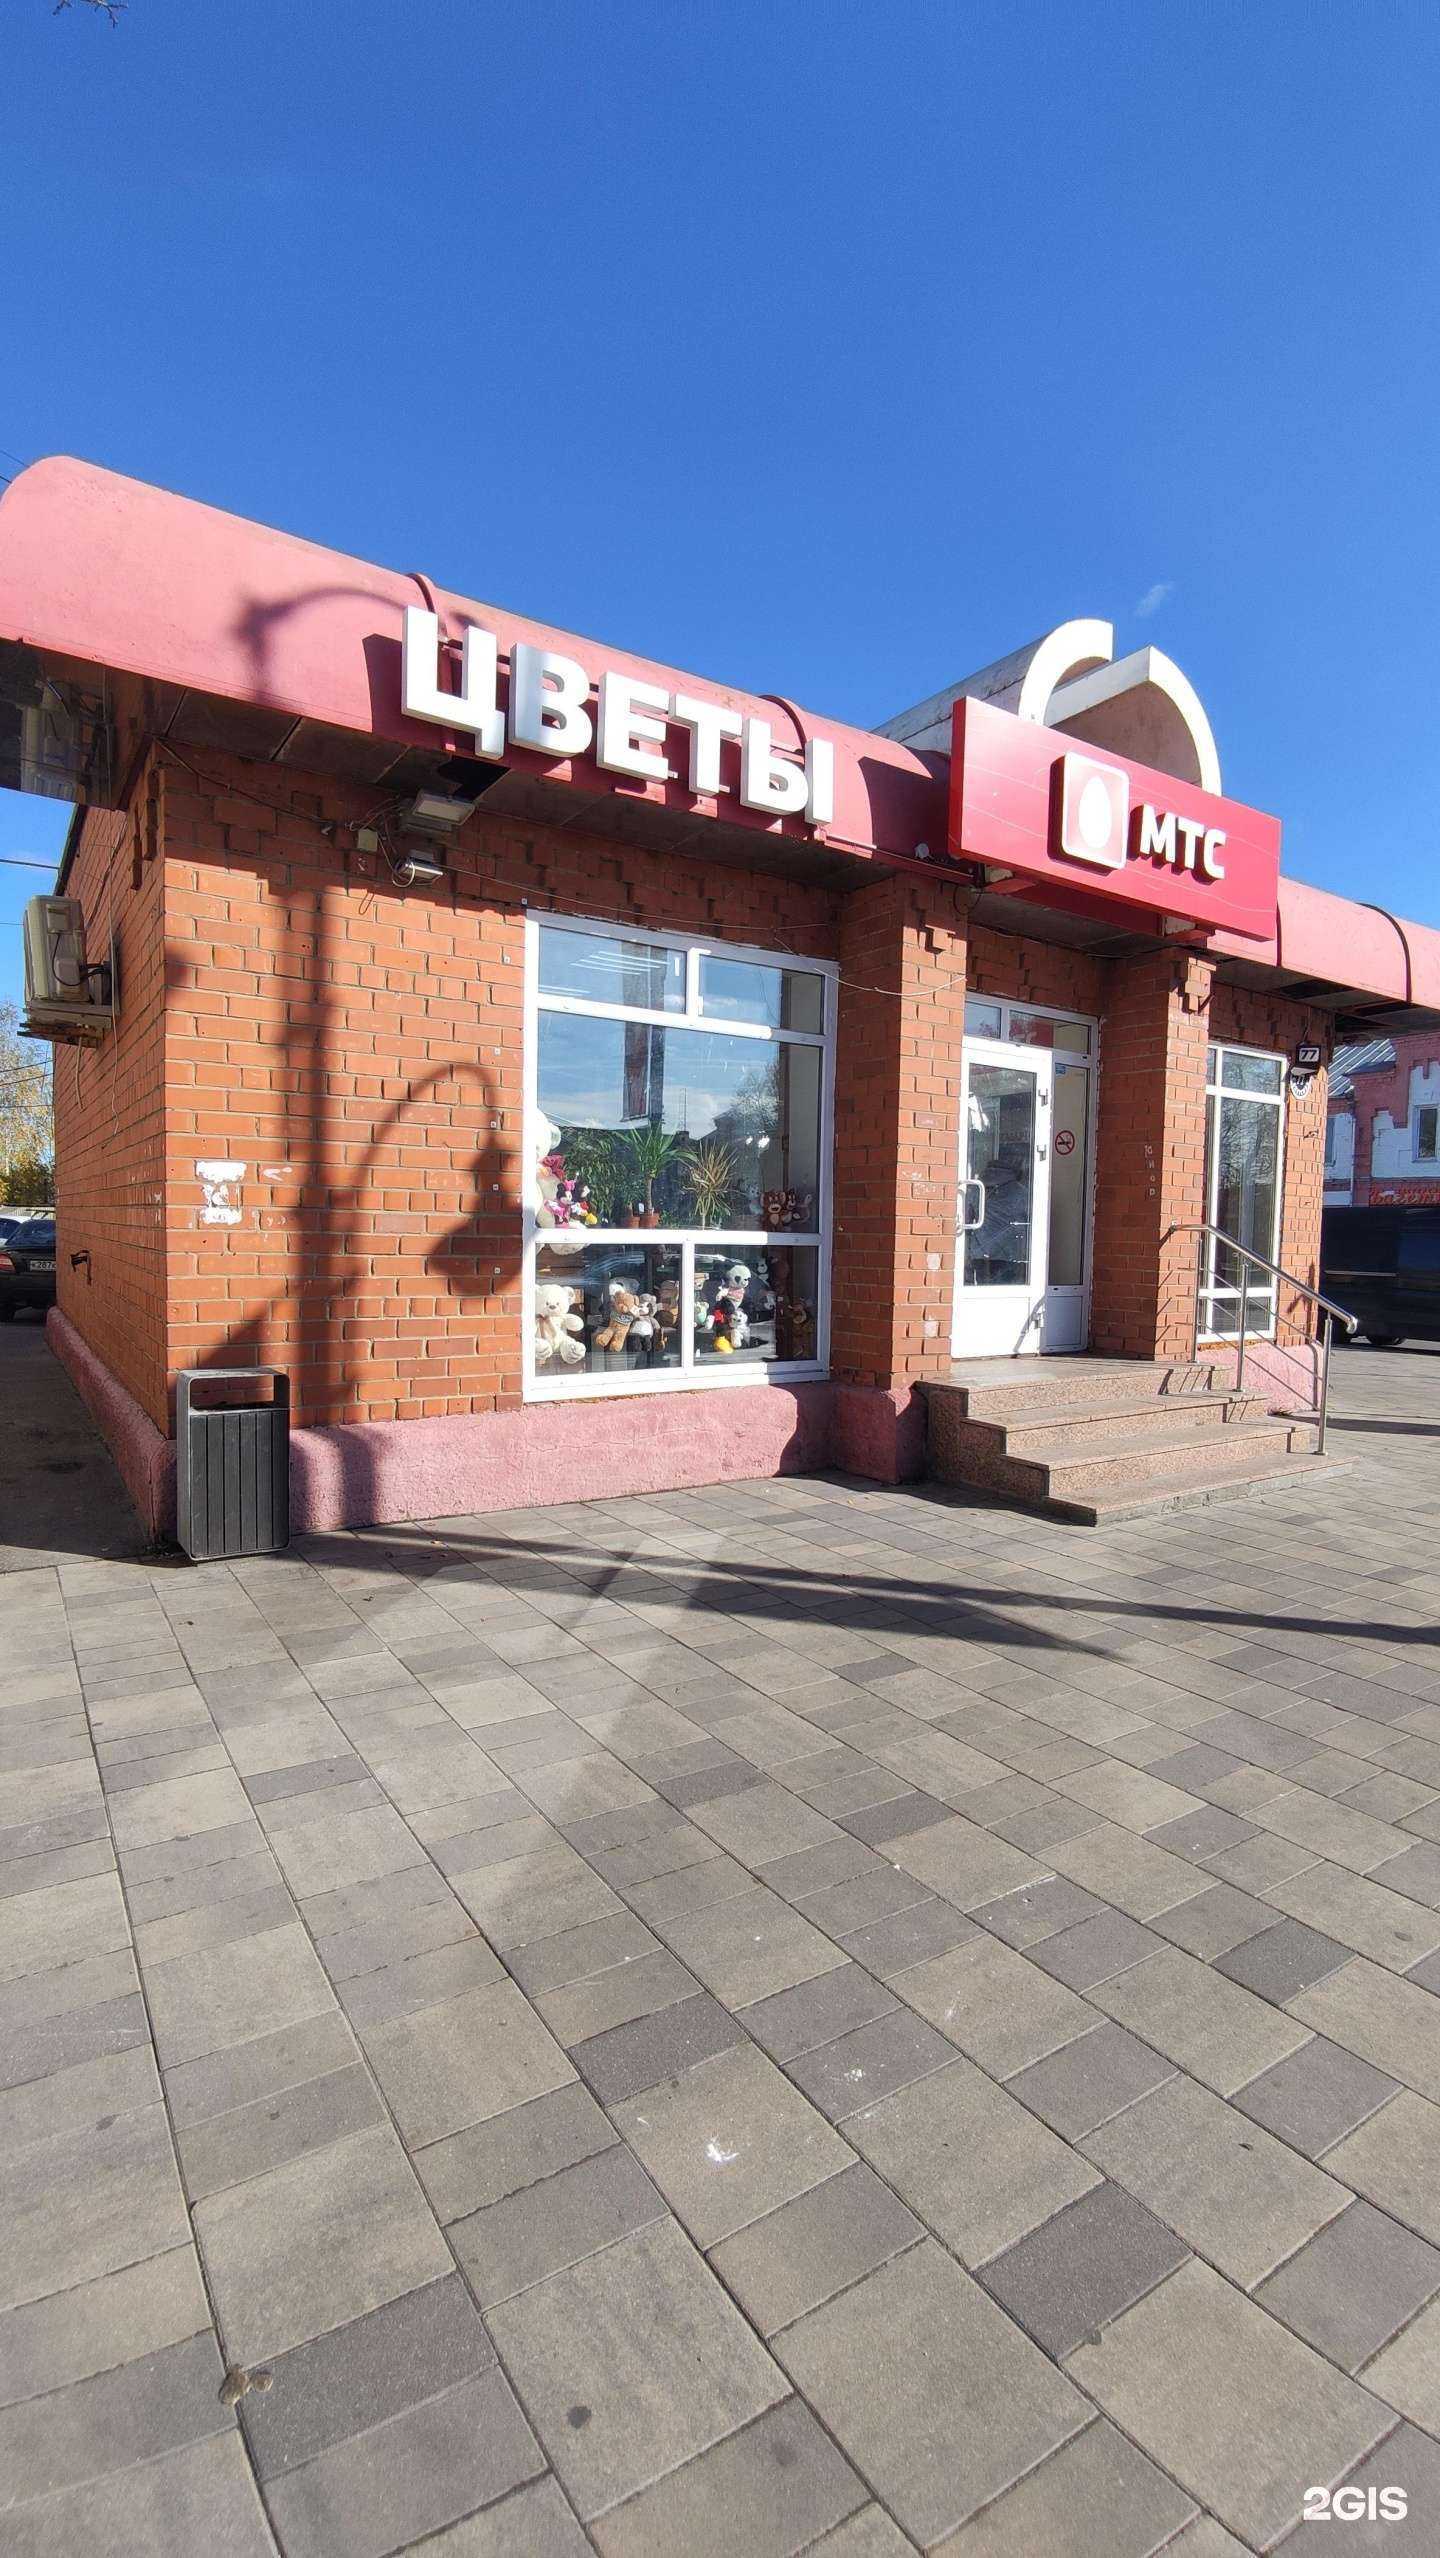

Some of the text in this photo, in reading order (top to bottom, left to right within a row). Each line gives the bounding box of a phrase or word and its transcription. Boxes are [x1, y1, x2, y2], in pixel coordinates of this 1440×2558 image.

[401, 605, 833, 824] ЦВЕТЫ
[1138, 803, 1227, 880] МТС
[1301, 1050, 1318, 1060] 77
